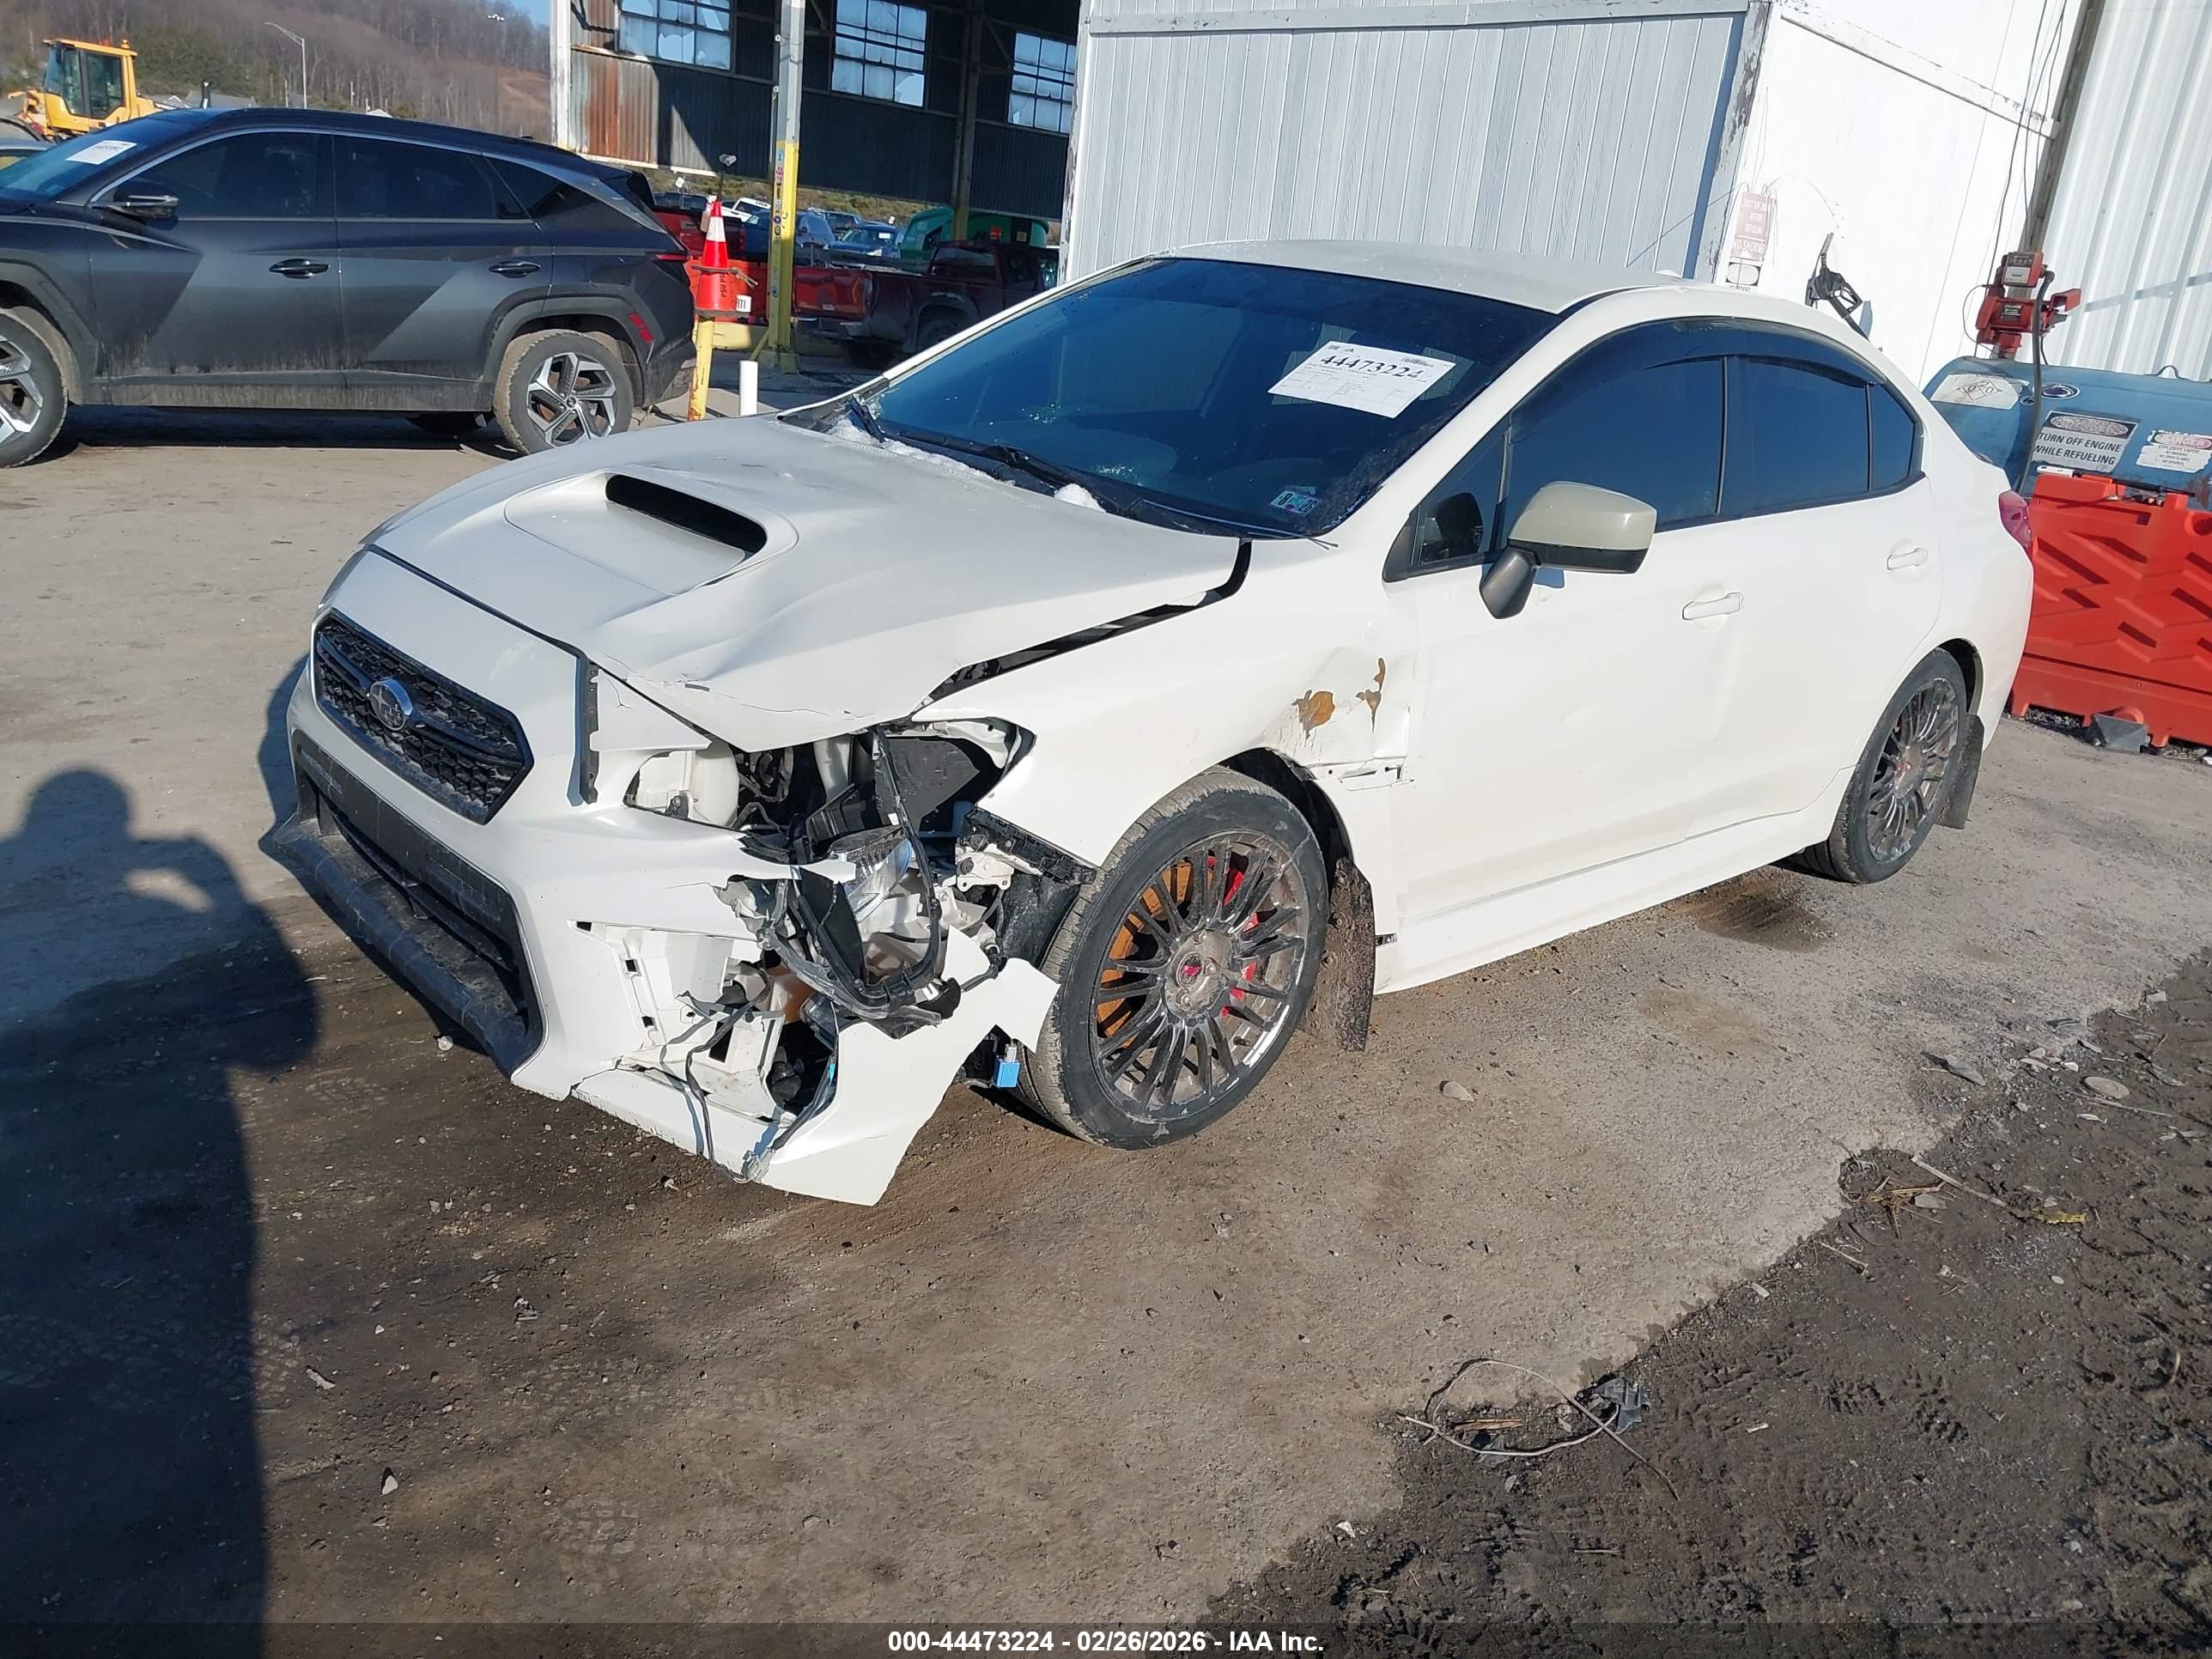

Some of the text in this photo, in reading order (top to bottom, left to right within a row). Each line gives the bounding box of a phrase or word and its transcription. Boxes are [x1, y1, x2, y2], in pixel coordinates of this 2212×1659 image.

[1321, 355, 1424, 379] 44473224
[2038, 432, 2122, 453] TURN OFF ENGINE
[2063, 449, 2117, 465] REFUELING
